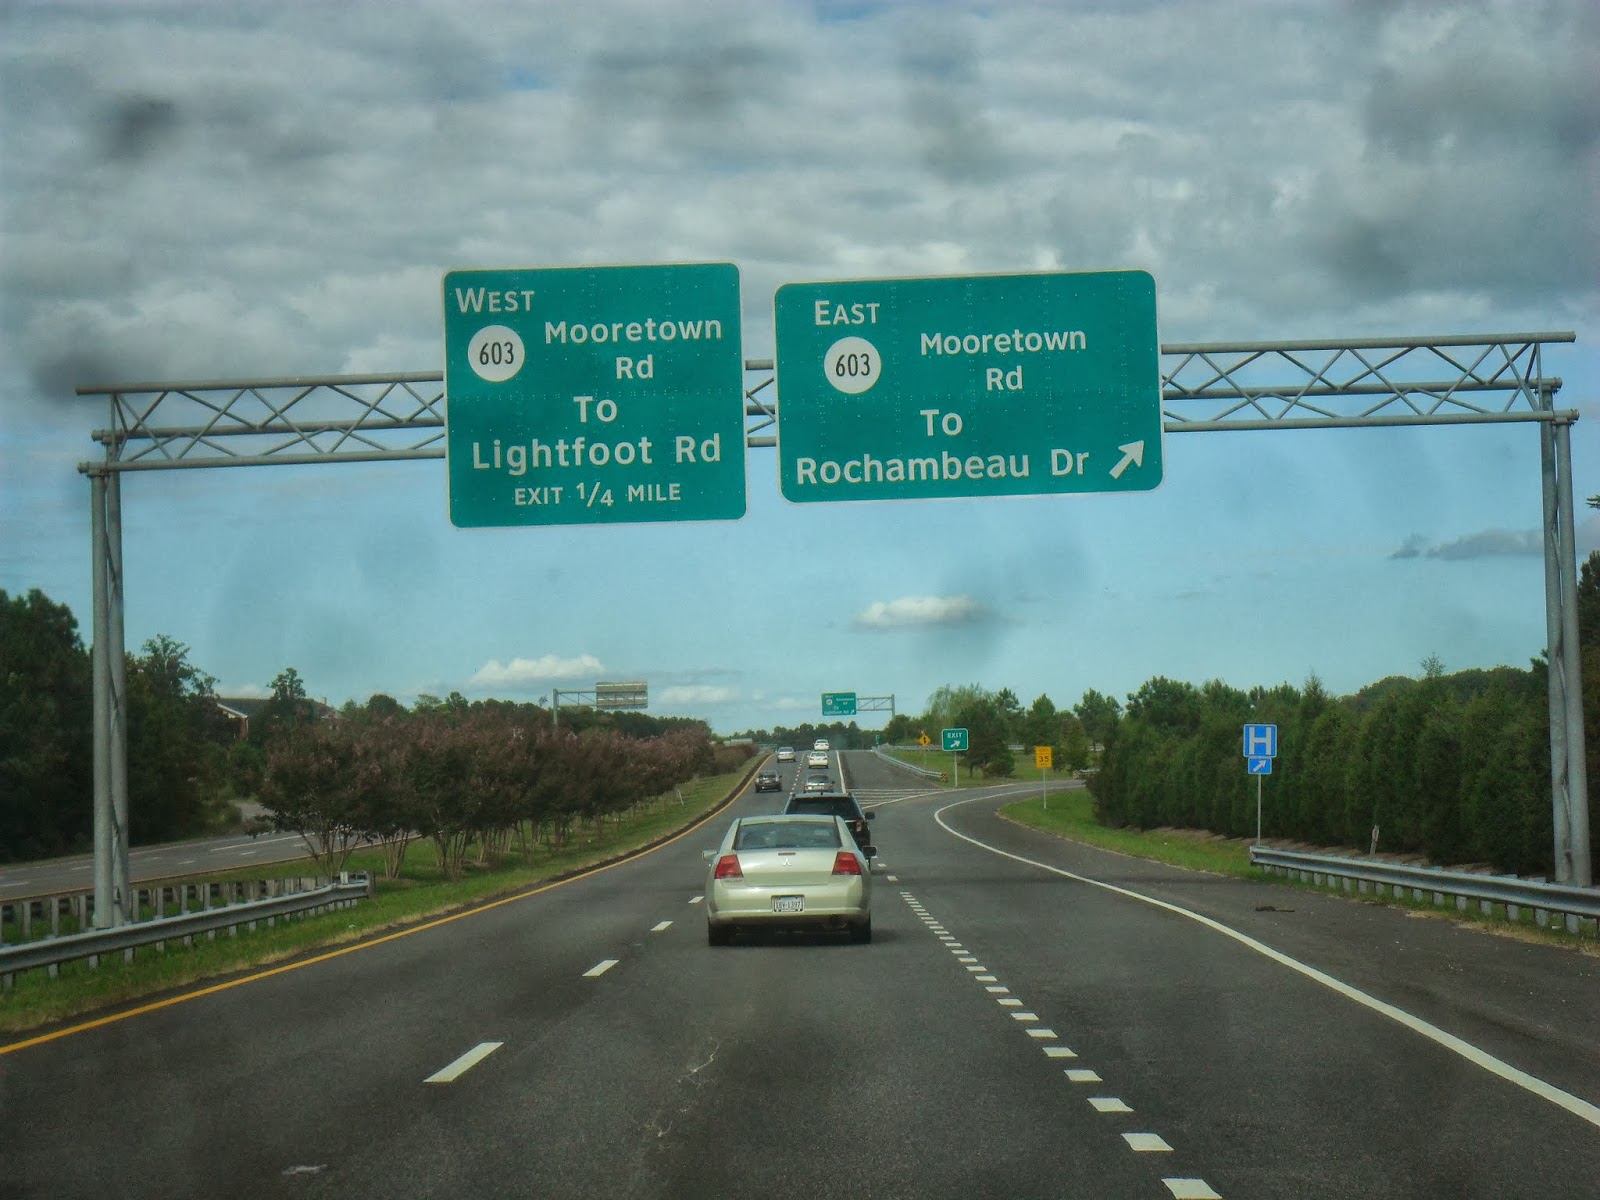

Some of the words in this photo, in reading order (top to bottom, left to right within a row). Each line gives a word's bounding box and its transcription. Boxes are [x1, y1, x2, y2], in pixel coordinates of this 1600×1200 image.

[456, 288, 534, 312] WEST
[815, 300, 880, 325] EAST
[546, 318, 721, 343] Mooretown
[921, 329, 1086, 355] Mooretown
[480, 342, 514, 365] 603
[836, 354, 870, 377] 603
[616, 355, 653, 379] Rd
[987, 366, 1022, 390] Rd
[474, 437, 652, 475] Lightfoot
[676, 433, 720, 462] Rd
[797, 451, 1029, 484] Rochambeau
[1051, 449, 1089, 475] Dr
[515, 487, 563, 505] EXIT
[577, 482, 613, 507] 1/4
[628, 484, 680, 501] MILE
[1249, 727, 1271, 755] H
